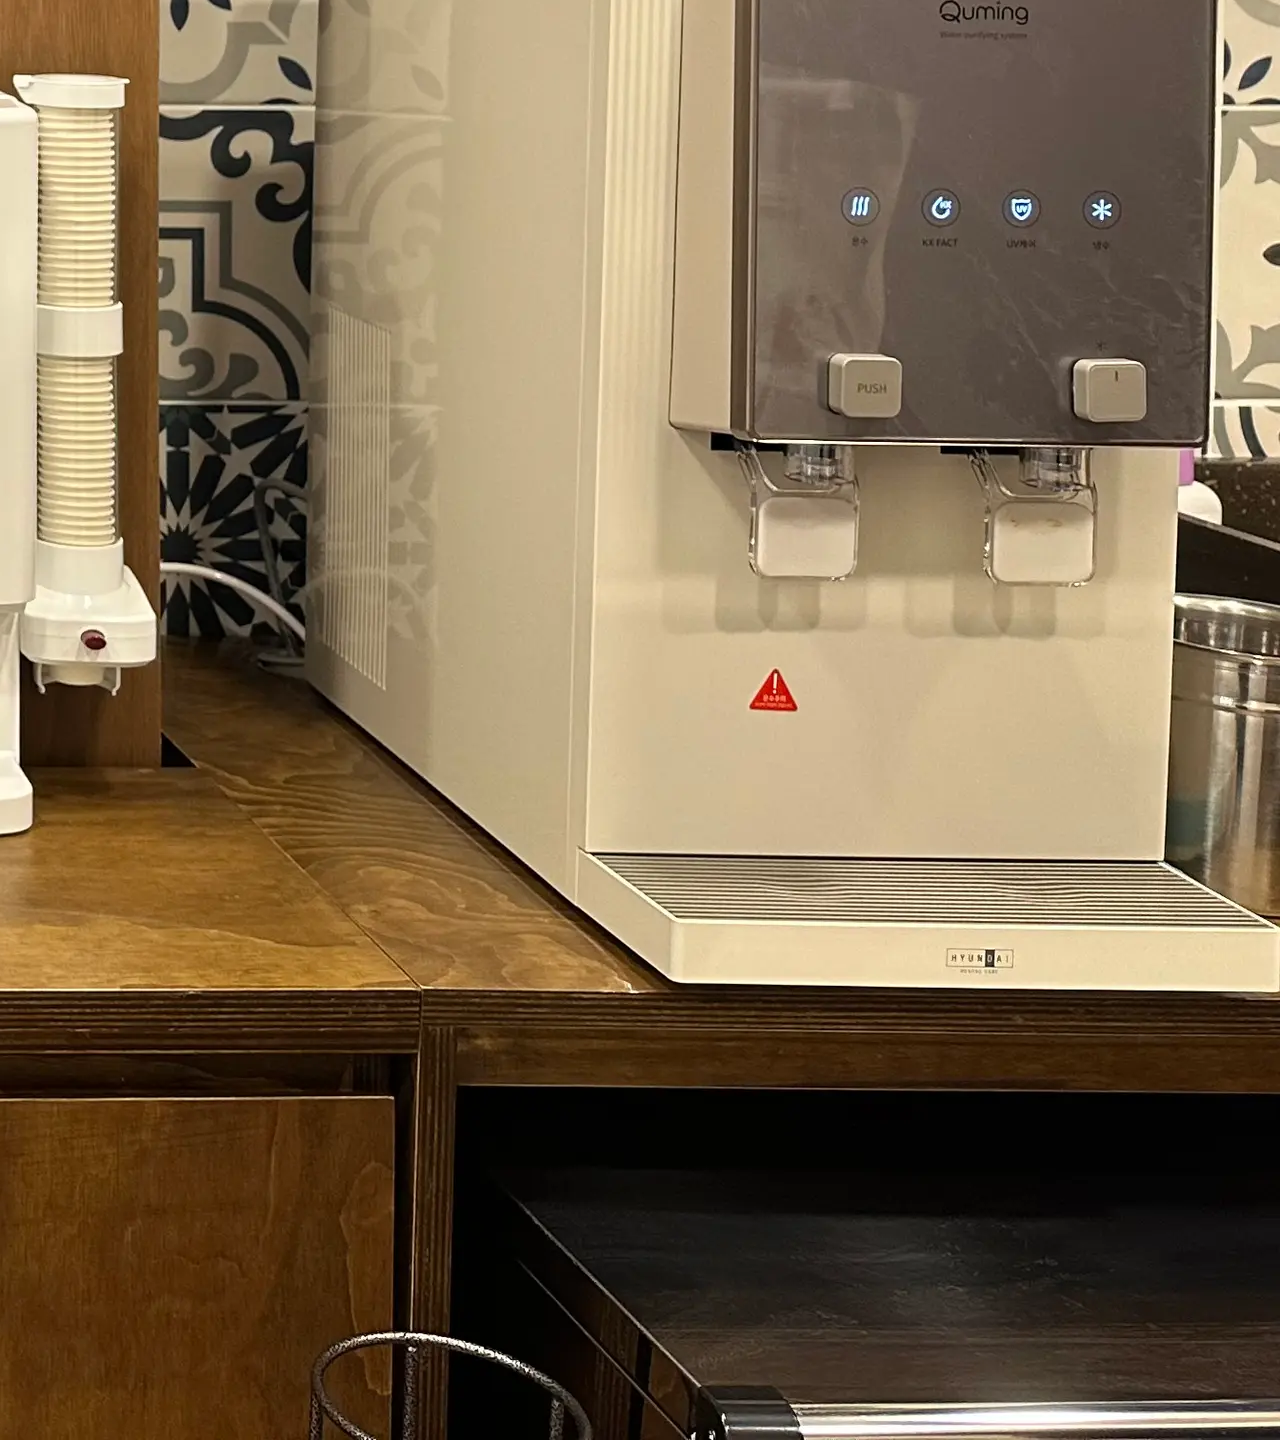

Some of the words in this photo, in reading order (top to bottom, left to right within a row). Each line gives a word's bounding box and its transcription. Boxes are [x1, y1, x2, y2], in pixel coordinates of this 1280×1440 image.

[940, 0, 1029, 25] Quming
[922, 239, 935, 248] KX
[857, 382, 887, 394] PUSH
[951, 954, 1009, 963] HYUNDAI
